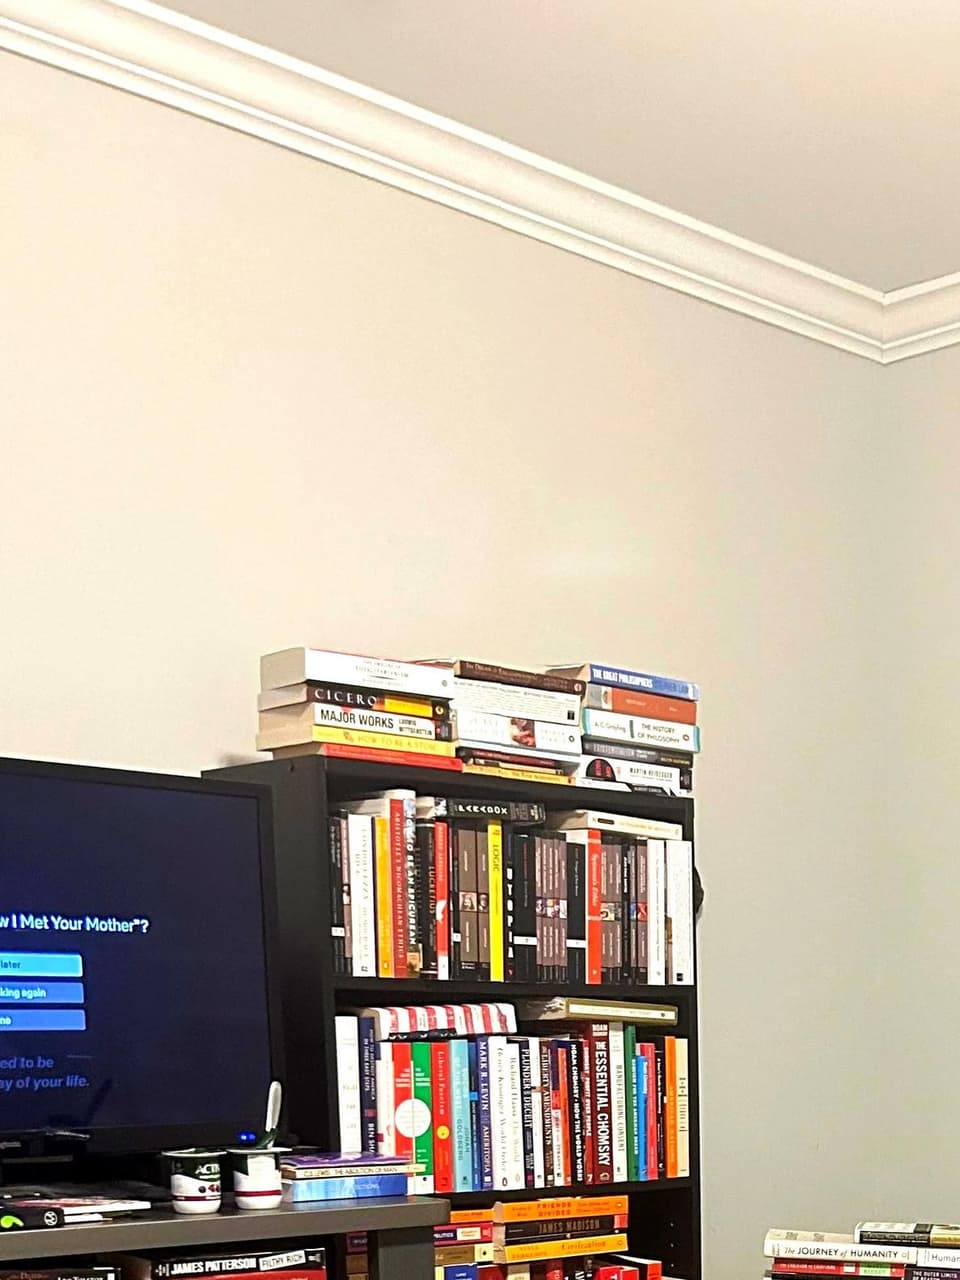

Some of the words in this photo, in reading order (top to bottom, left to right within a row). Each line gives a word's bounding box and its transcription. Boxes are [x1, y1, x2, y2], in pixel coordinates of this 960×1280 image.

[315, 689, 377, 706] CICERO
[321, 710, 355, 723] MAJOR
[359, 715, 394, 729] WORKS
[458, 804, 508, 815] PARADOX
[12, 915, 16, 928] I
[20, 915, 49, 929] Met
[51, 916, 82, 930] Your
[1, 961, 20, 969] later
[22, 988, 46, 999] again
[20, 1057, 34, 1068] to
[37, 1057, 54, 1068] be
[16, 1077, 30, 1087] of
[33, 1077, 62, 1090] your
[66, 1076, 90, 1087] life.
[595, 1052, 608, 1110] ESSENTIAL
[597, 1113, 610, 1166] CHOMSKY
[262, 1255, 284, 1268] FILTHY
[286, 1252, 304, 1263] RICH
[784, 1247, 796, 1256] The
[798, 1247, 839, 1257] JOURNEY
[840, 1248, 849, 1258] of
[851, 1249, 898, 1259] HUMANITY
[171, 1262, 203, 1275] JAMES
[206, 1258, 256, 1272] PATTERSON
